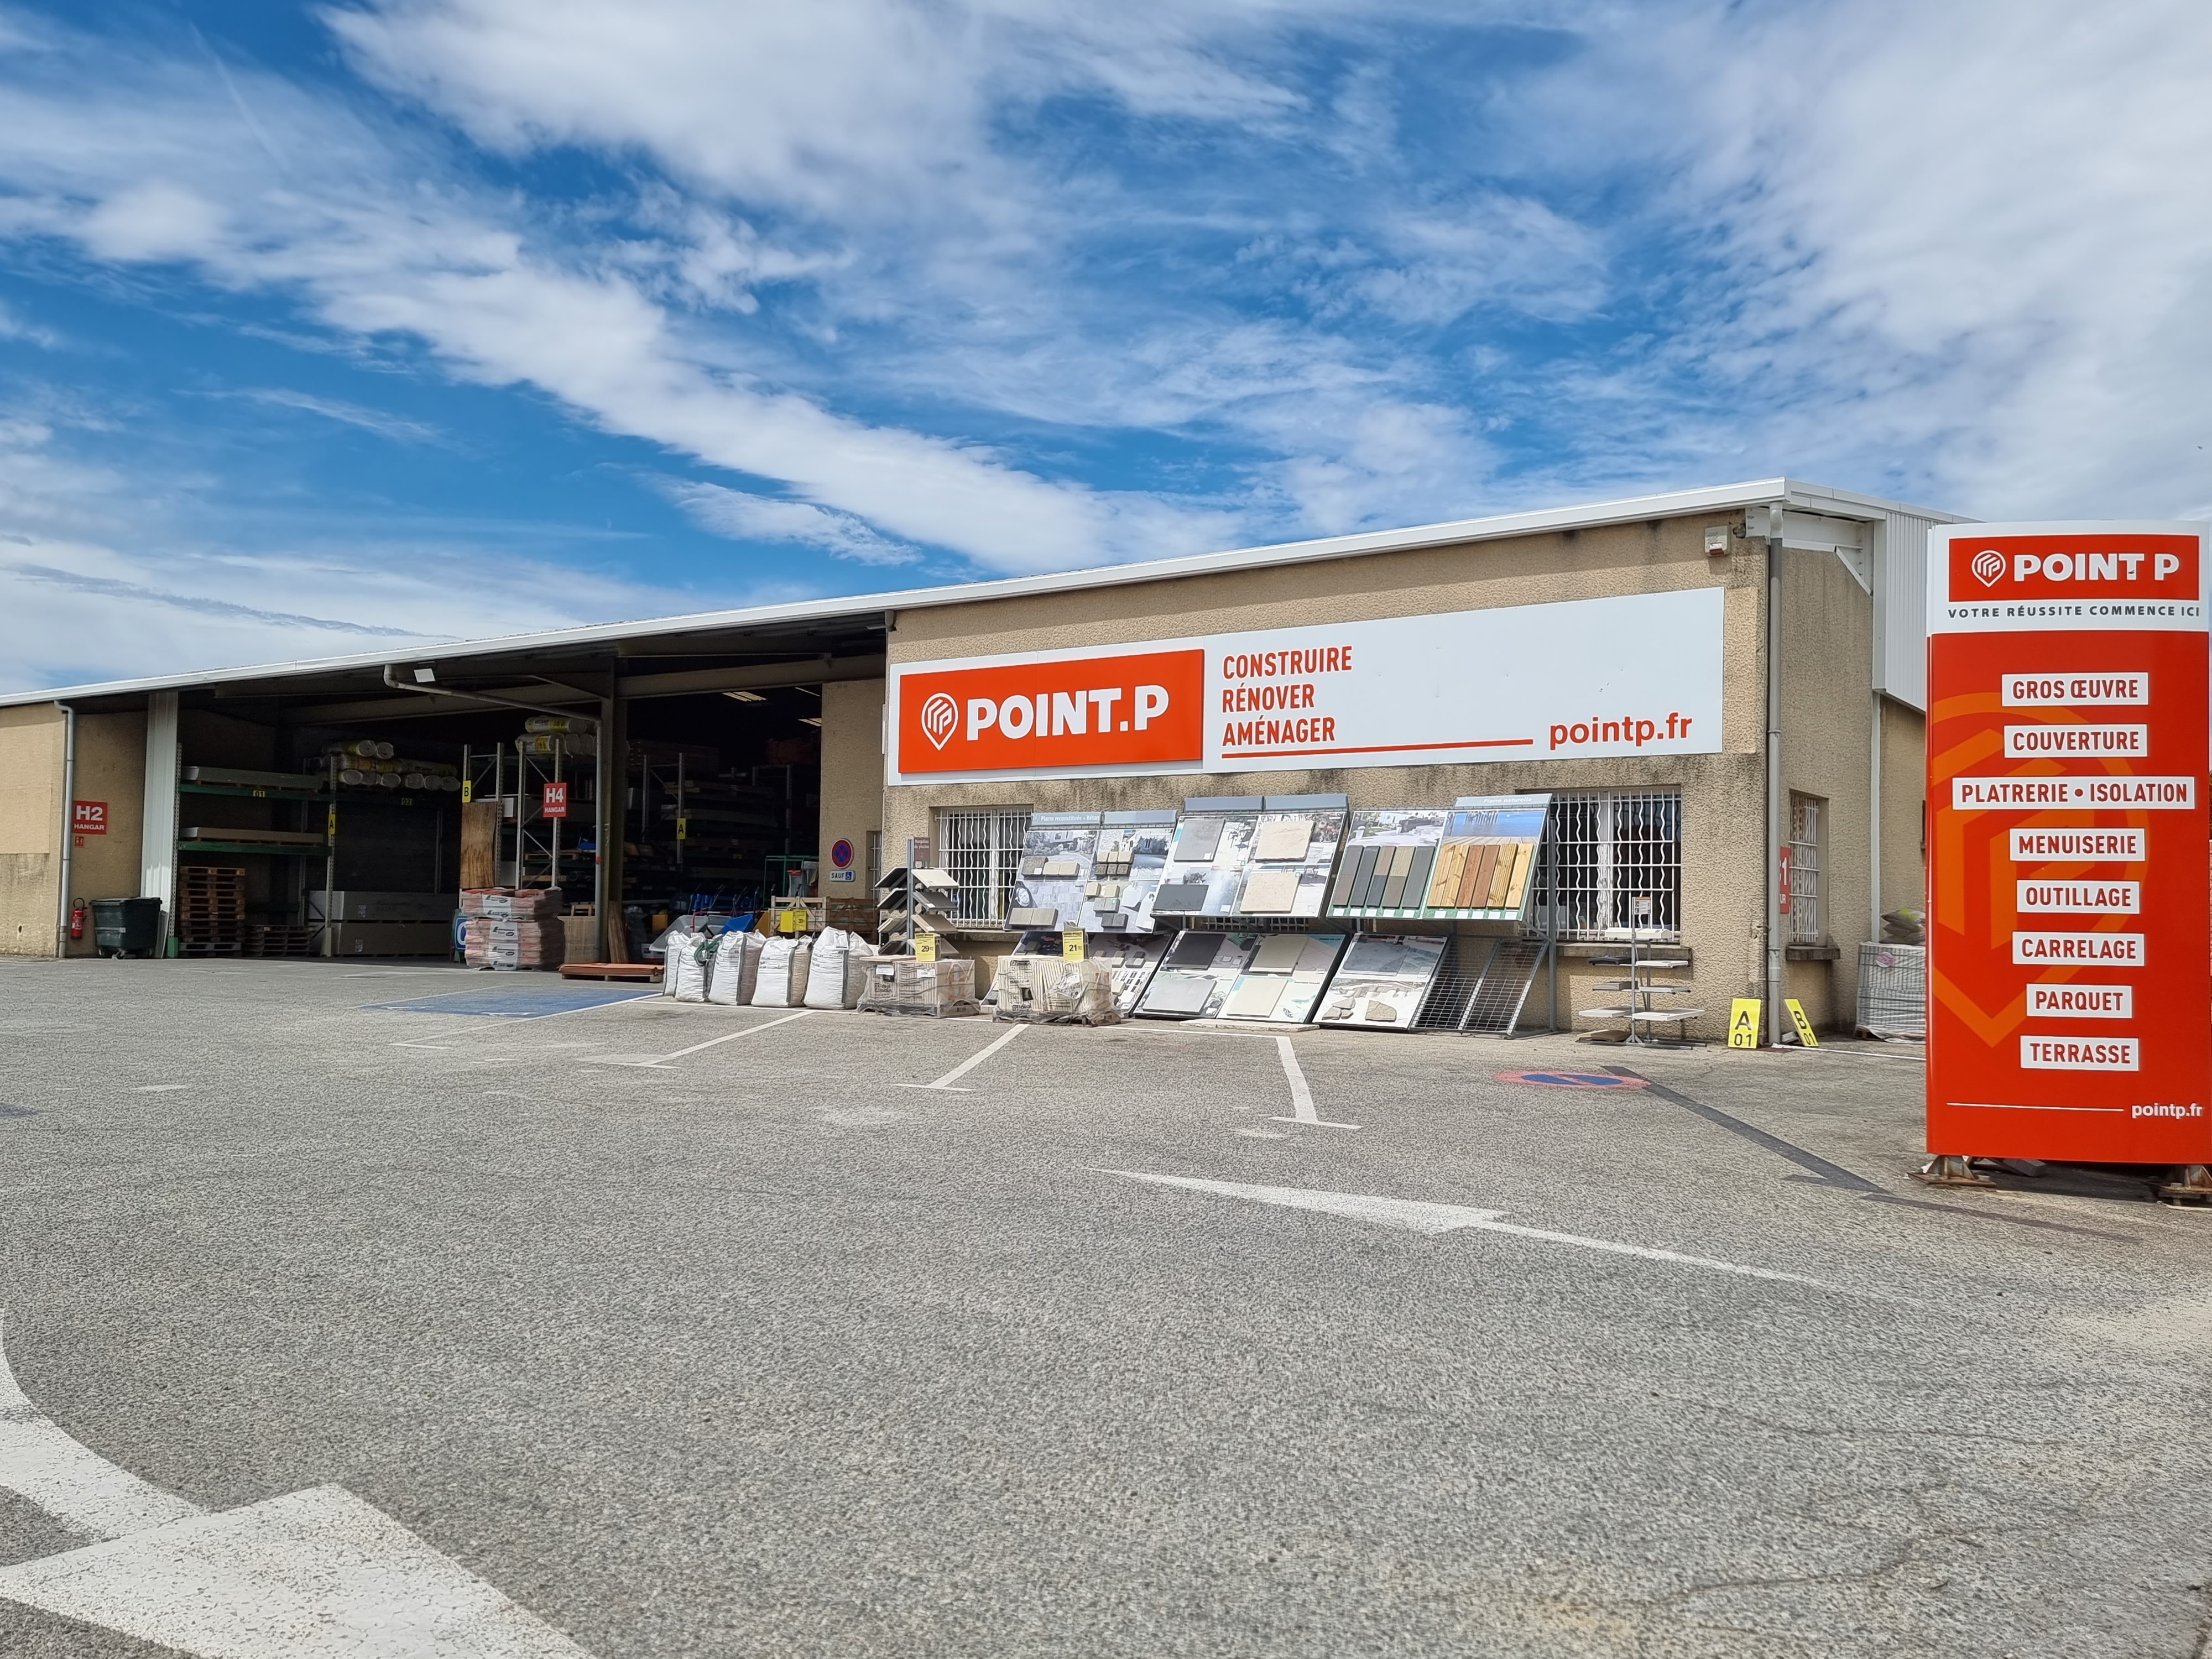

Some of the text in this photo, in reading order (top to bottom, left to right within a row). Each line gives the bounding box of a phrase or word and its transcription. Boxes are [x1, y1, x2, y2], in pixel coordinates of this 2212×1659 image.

[2014, 553, 2179, 582] POINT P
[1948, 605, 2200, 618] VOTRE RÉUSSITE COMMENCE ICI
[1223, 646, 1352, 679] CONSTRUIRE
[1222, 682, 1314, 713] RÉNOVER
[2013, 679, 2138, 699] GROS ŒUVRE
[967, 685, 1169, 741] POINT.P
[1223, 715, 1335, 747] AMÉNAGER
[1550, 712, 1693, 750] pointp.fr
[2013, 731, 2139, 750] COUVERTURE
[464, 787, 469, 797] B
[546, 787, 564, 804] H4
[1961, 783, 2188, 803] PLATRERIE ISOLATION
[76, 805, 103, 821] H2
[329, 820, 333, 830] A
[678, 823, 684, 834] A
[2018, 835, 2136, 854] MENUISERIE
[2026, 887, 2131, 907] OUTILLAGE
[2022, 938, 2136, 959] CARRELAGE
[2035, 990, 2124, 1011] PARQUET
[1734, 1010, 1752, 1031] A
[1793, 1010, 1807, 1030] B
[1734, 1033, 1752, 1047] 01
[1803, 1032, 1816, 1045] 01
[2030, 1043, 2131, 1064] TERRASSE
[2131, 1102, 2203, 1119] pointp.fr
